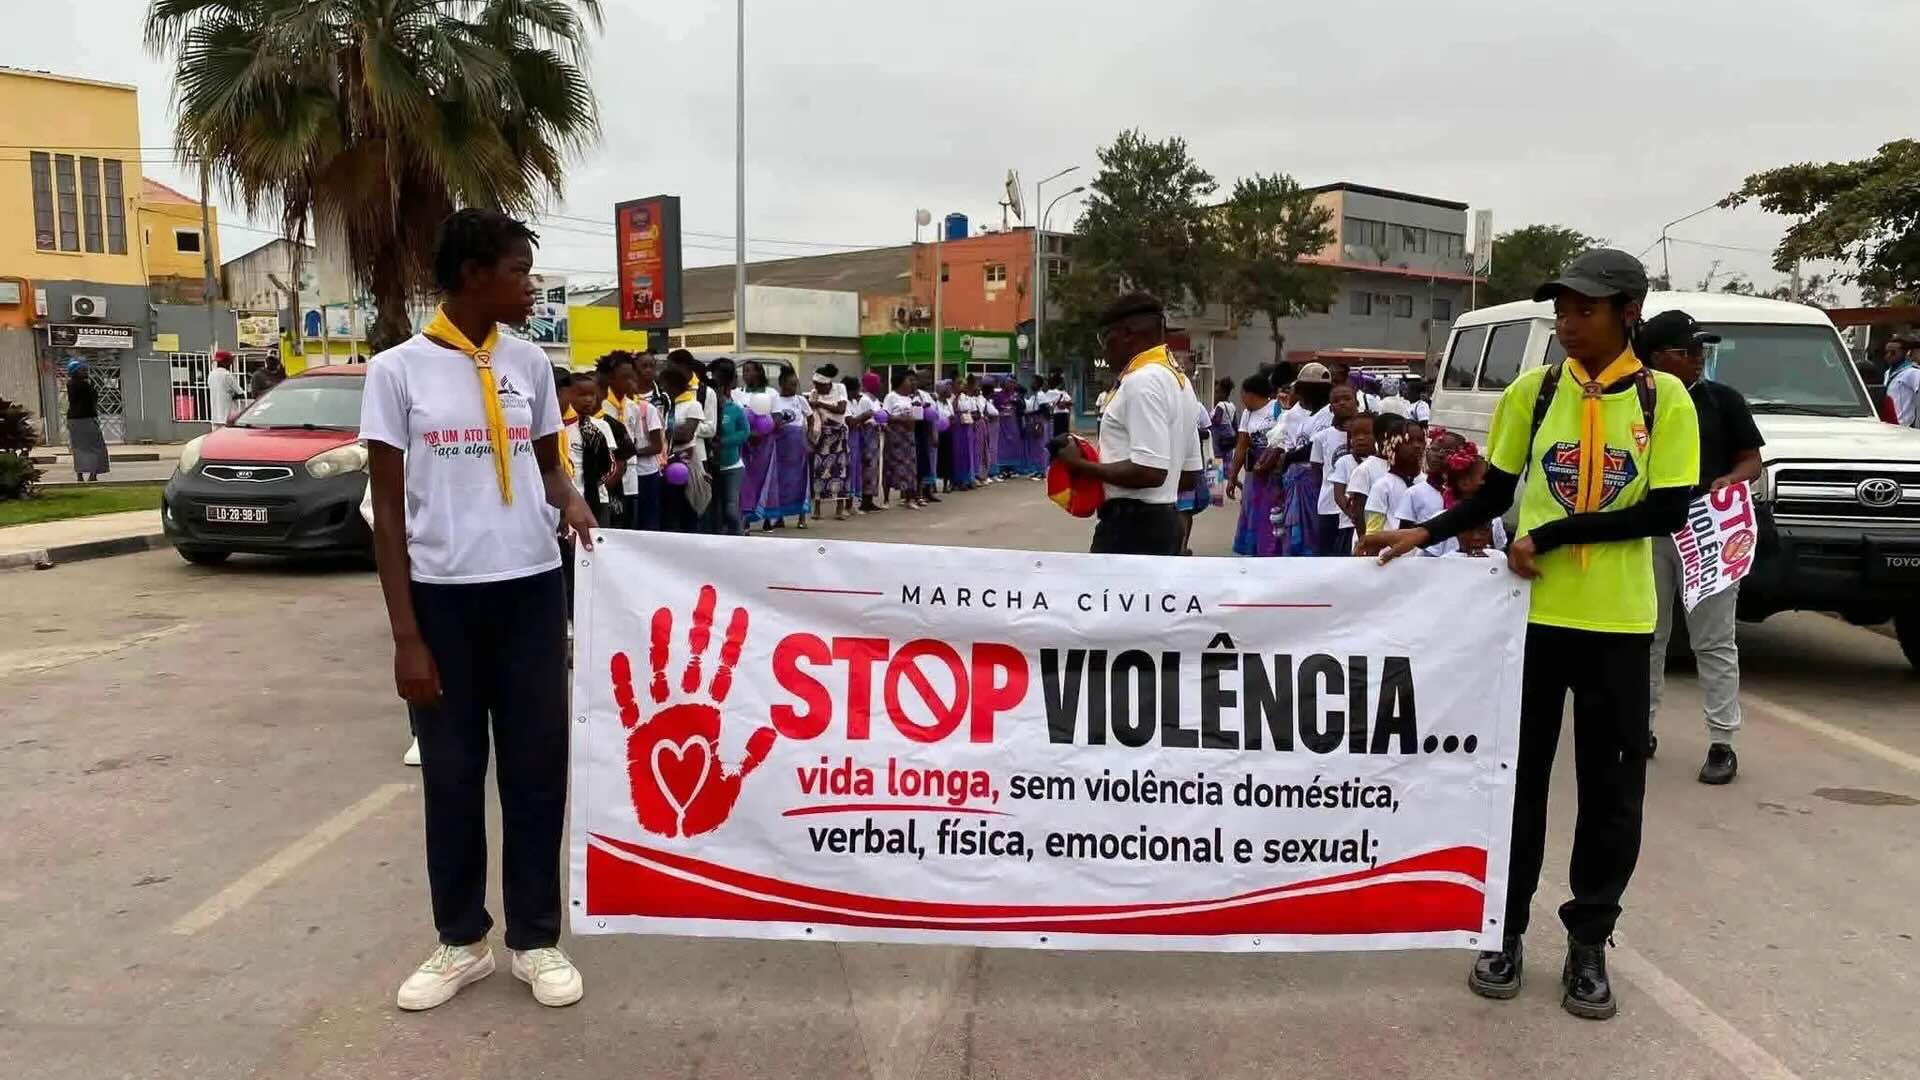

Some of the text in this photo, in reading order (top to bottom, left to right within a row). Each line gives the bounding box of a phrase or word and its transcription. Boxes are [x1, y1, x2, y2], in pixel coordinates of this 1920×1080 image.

[78, 328, 129, 336] ESCRITÓRIO
[442, 430, 459, 443] UM
[464, 429, 482, 442] ATO
[1710, 482, 1756, 581] STOP
[902, 584, 1203, 614] MARCHA CÍVICA
[769, 632, 1479, 755] STOP VIOLÊNCIA...
[797, 756, 1400, 814] vida longa, sem violência doméstica,
[808, 818, 1379, 869] verbal, física, emocional e sexual;
